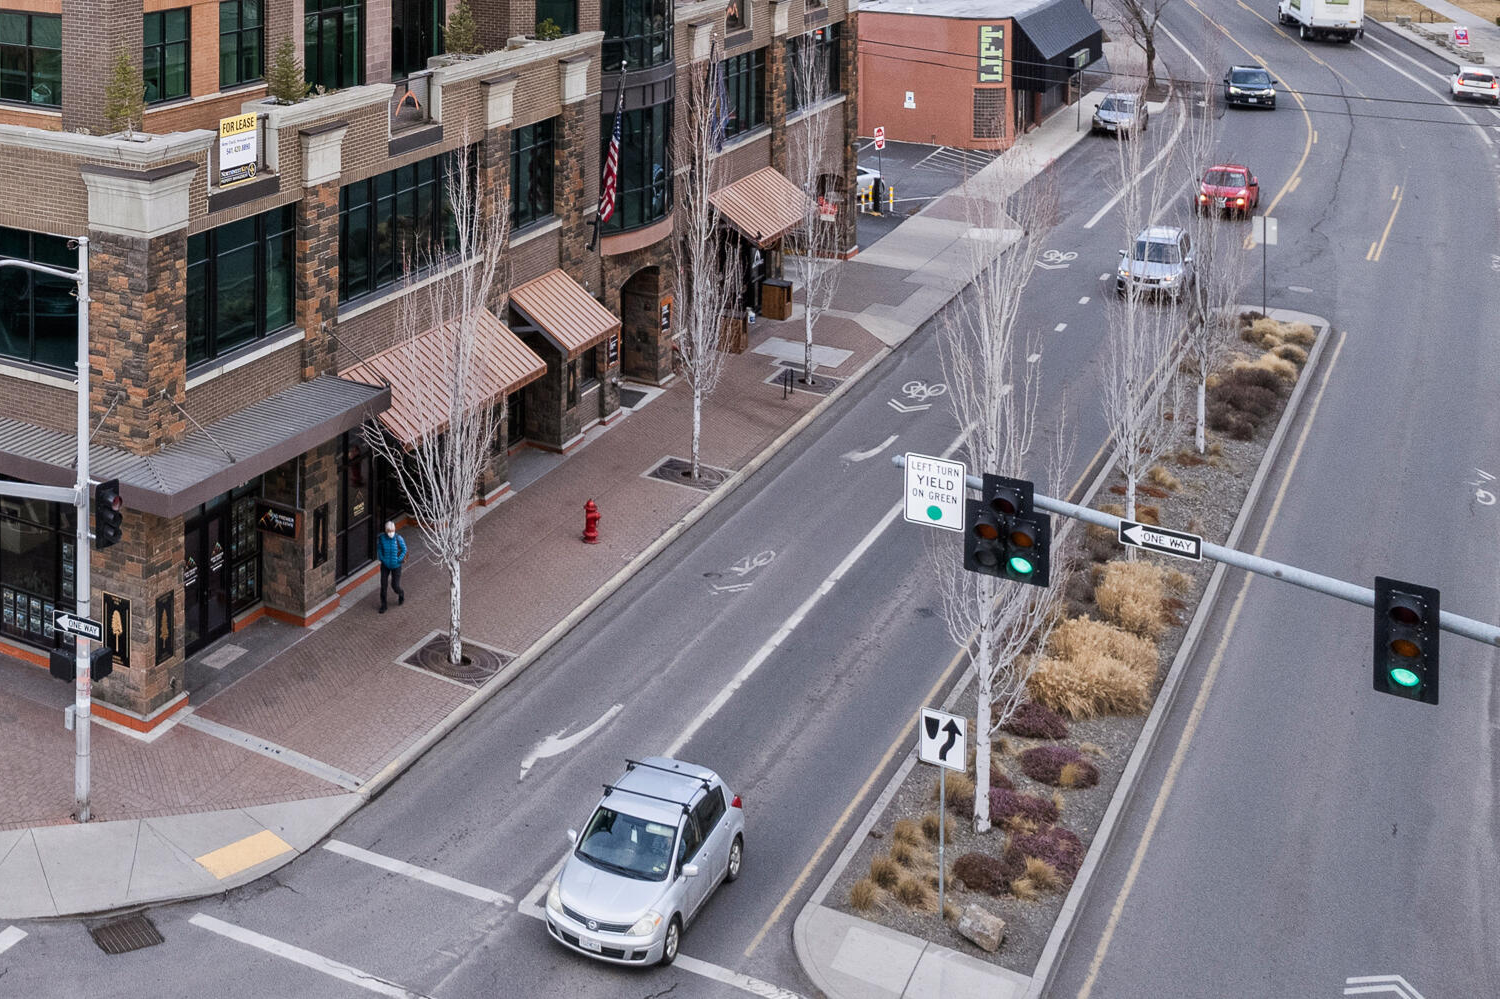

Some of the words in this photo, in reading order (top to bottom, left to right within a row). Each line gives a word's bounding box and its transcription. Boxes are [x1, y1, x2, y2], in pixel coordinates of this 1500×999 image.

[980, 26, 1003, 82] LIFT
[222, 121, 234, 133] FOR
[235, 117, 254, 131] LEASE
[911, 461, 932, 472] LEFT
[936, 465, 959, 477] TURN
[917, 474, 954, 491] YIELD
[912, 488, 924, 498] ON
[929, 491, 957, 504] GREEN
[1143, 532, 1165, 546] ONE
[1169, 538, 1192, 551] WAY
[69, 620, 83, 629] ONE
[84, 624, 97, 634] WAY
